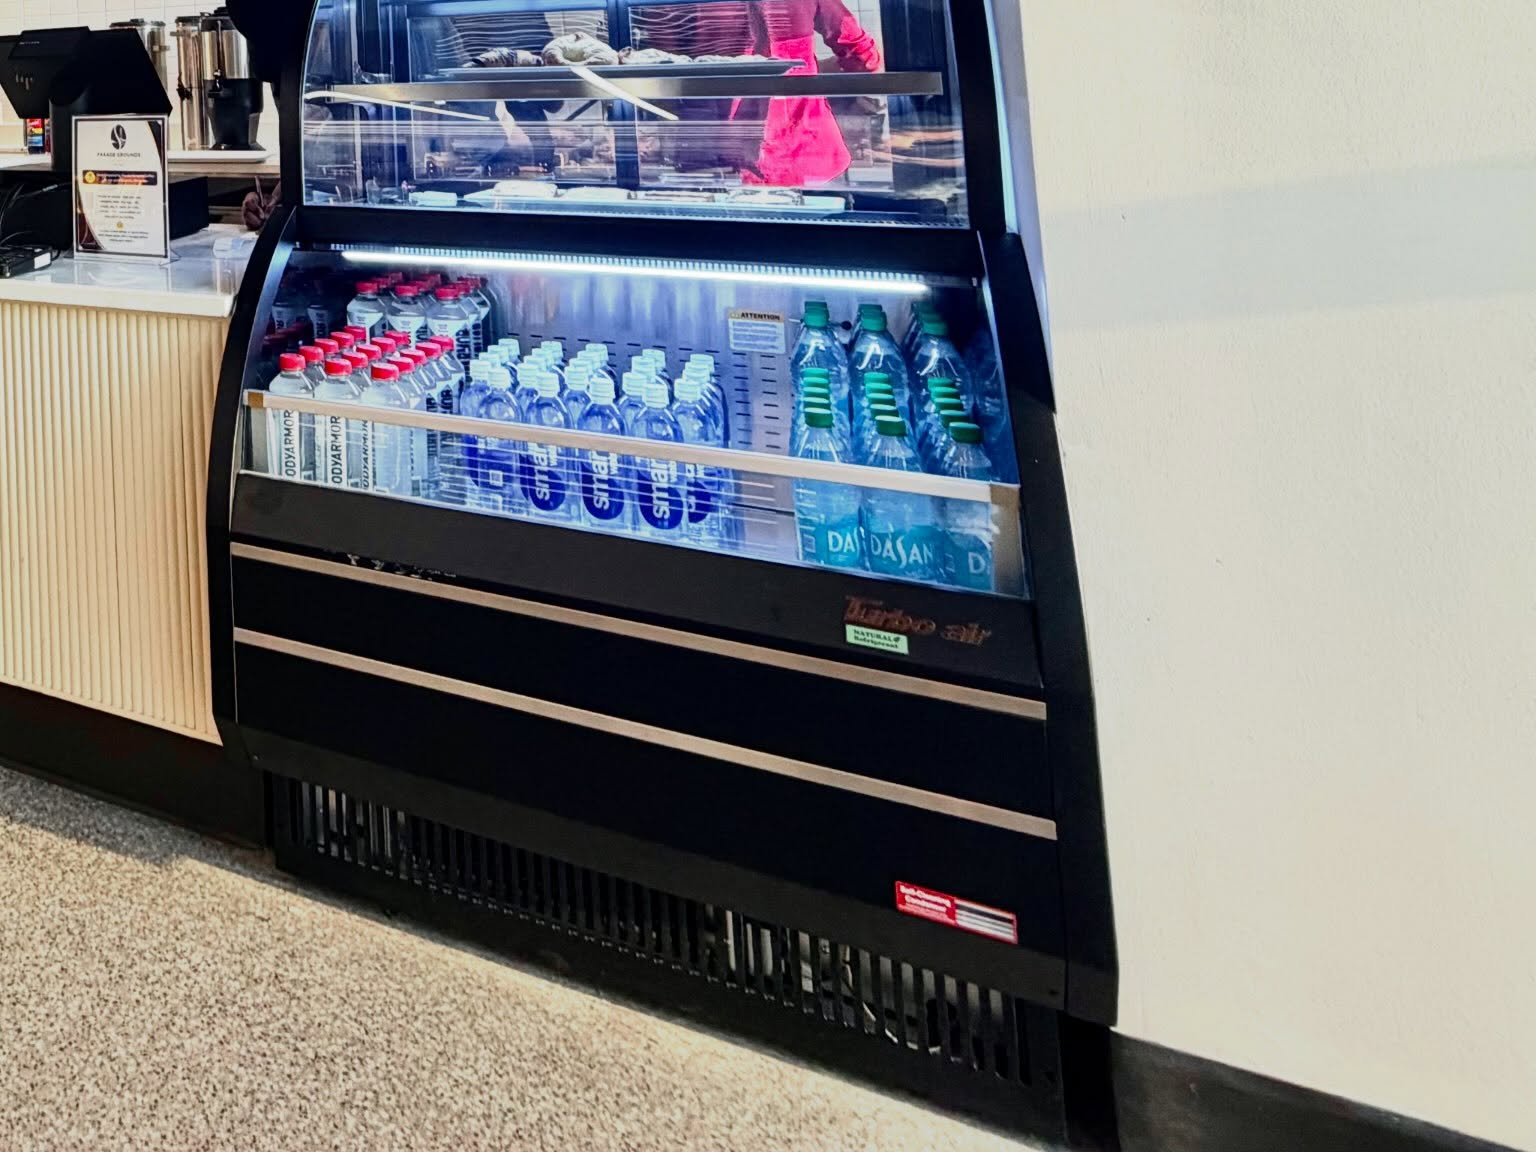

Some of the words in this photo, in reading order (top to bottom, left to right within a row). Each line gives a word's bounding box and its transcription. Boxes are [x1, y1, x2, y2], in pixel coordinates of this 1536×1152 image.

[740, 312, 781, 321] ATTENTION
[284, 409, 297, 477] ODYARMOR
[330, 415, 343, 484] ODYARMOR
[528, 443, 551, 501] smar
[591, 451, 610, 510] smar
[650, 458, 671, 519] smar
[870, 526, 933, 569] DASAN
[853, 629, 892, 642] NATURAL
